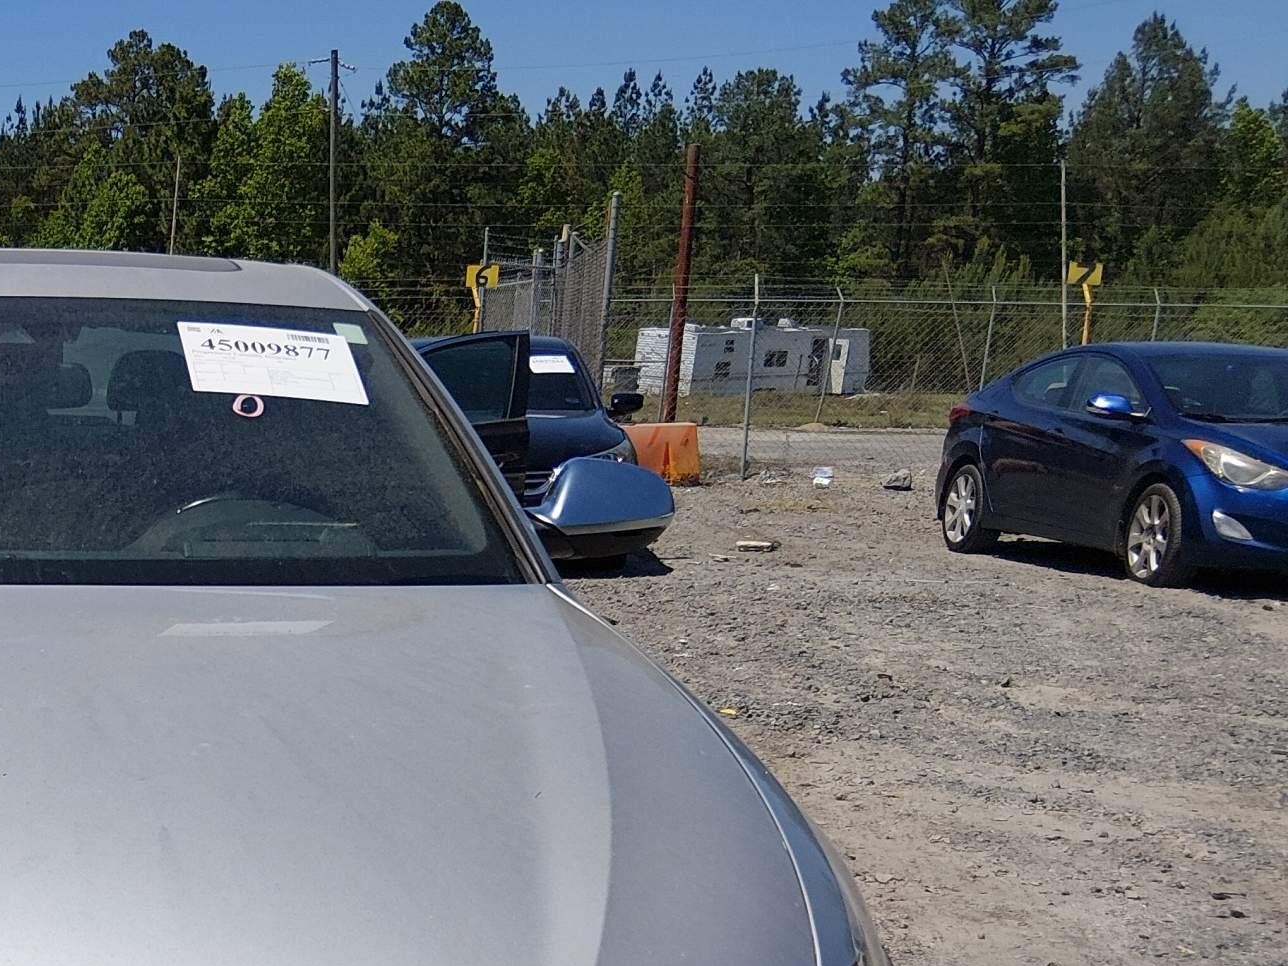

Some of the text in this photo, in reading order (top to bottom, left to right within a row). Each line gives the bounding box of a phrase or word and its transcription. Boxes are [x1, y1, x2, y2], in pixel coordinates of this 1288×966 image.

[475, 262, 495, 286] 6
[1075, 261, 1097, 285] 7
[200, 337, 331, 361] 45009877
